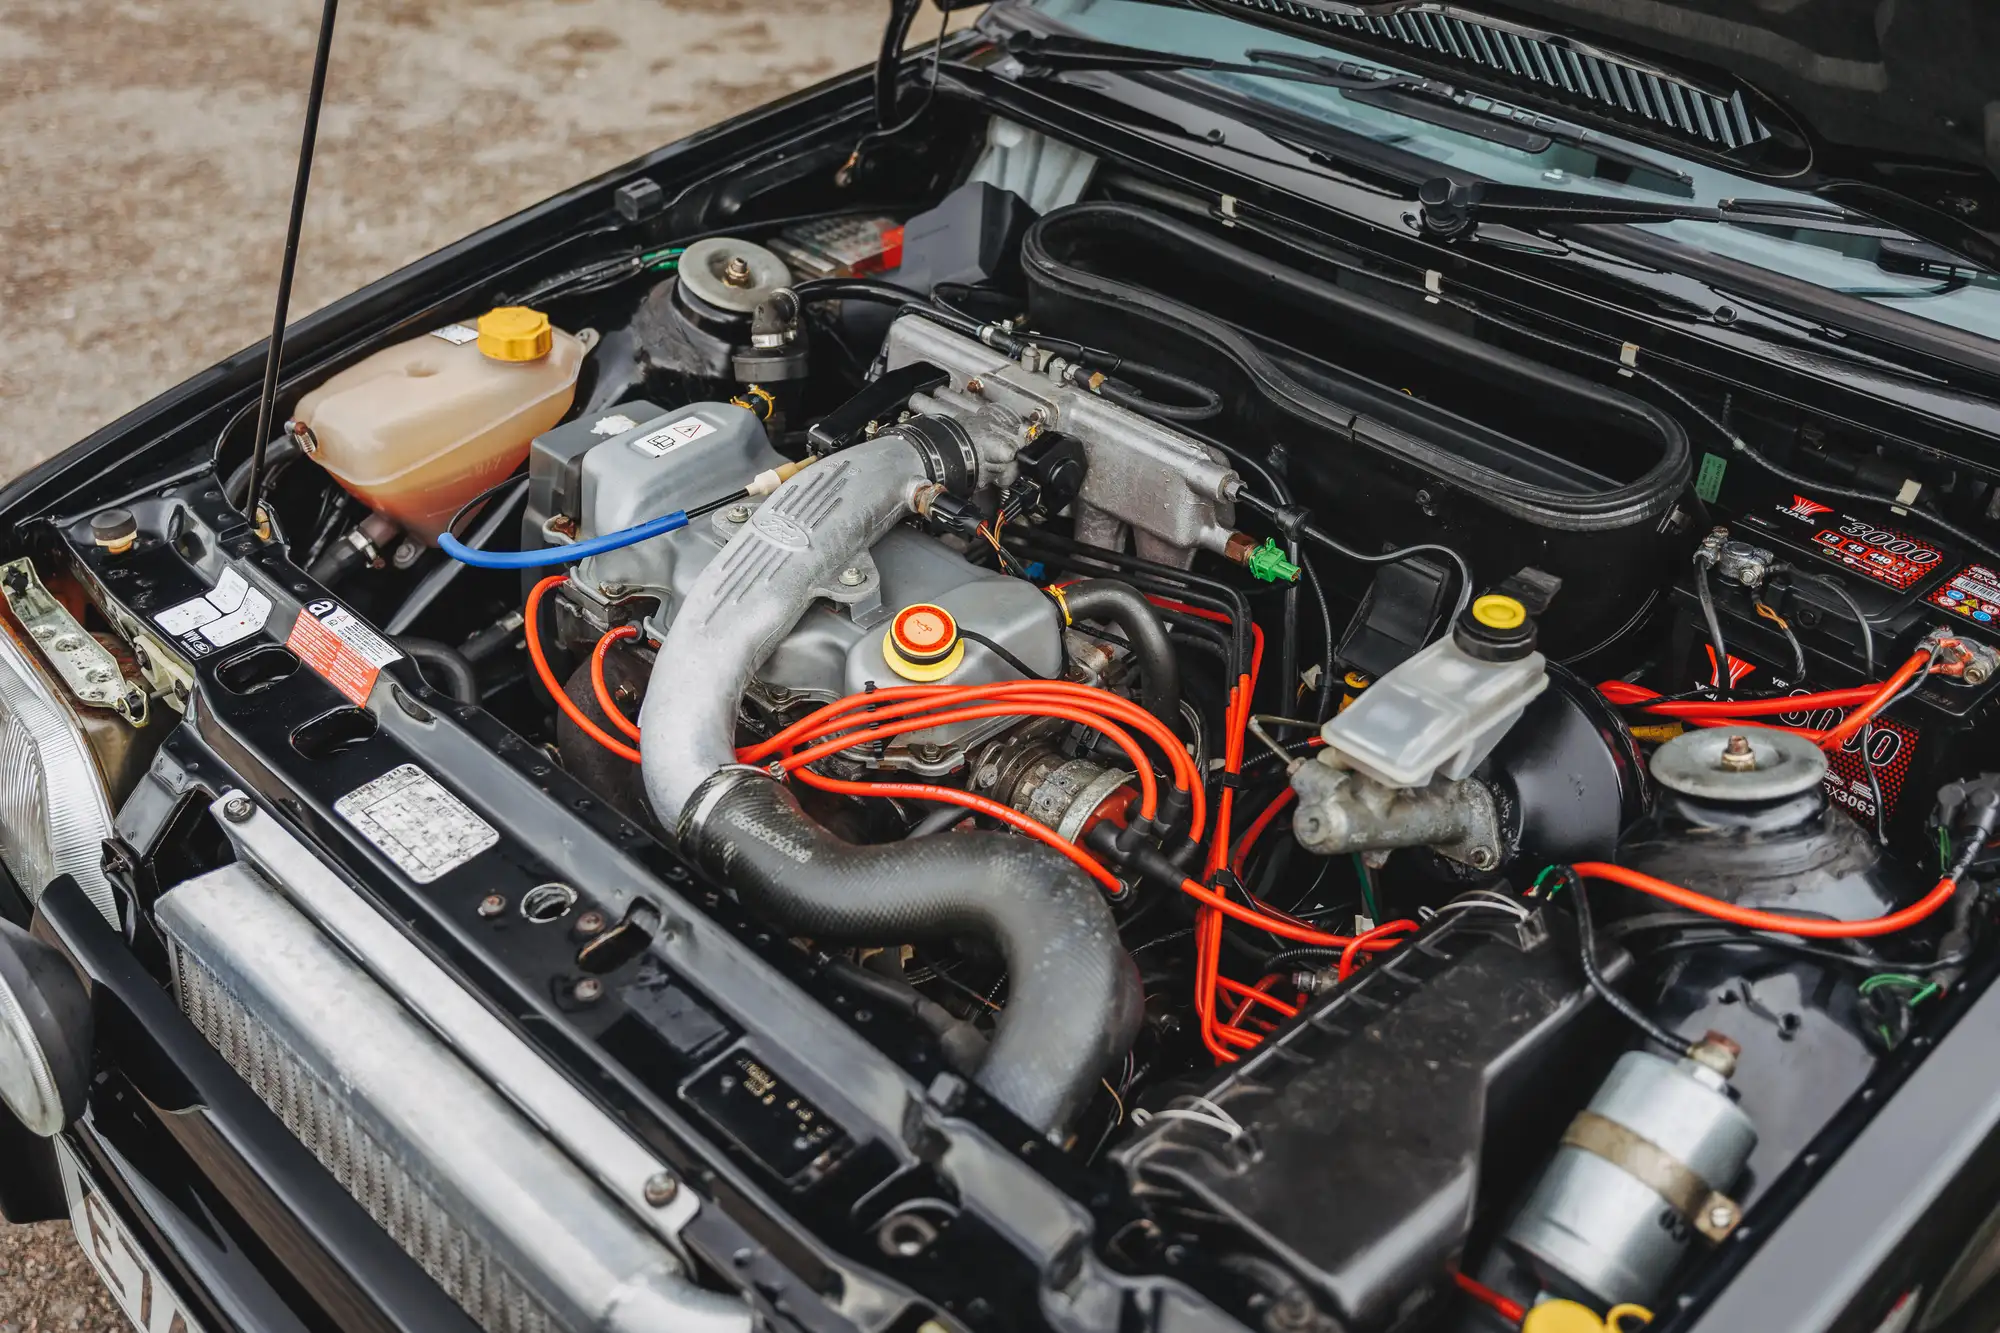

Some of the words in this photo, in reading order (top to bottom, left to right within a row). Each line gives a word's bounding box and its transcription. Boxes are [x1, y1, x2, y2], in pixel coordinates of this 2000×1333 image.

[1775, 504, 1816, 525] YUASA
[1824, 533, 1840, 542] 12
[1839, 522, 1940, 564] 3000
[1848, 543, 1865, 553] 45
[1869, 552, 1892, 564] 440
[1772, 676, 1789, 688] YB
[1821, 781, 1876, 816] BX3063
[77, 1169, 188, 1333] E7
